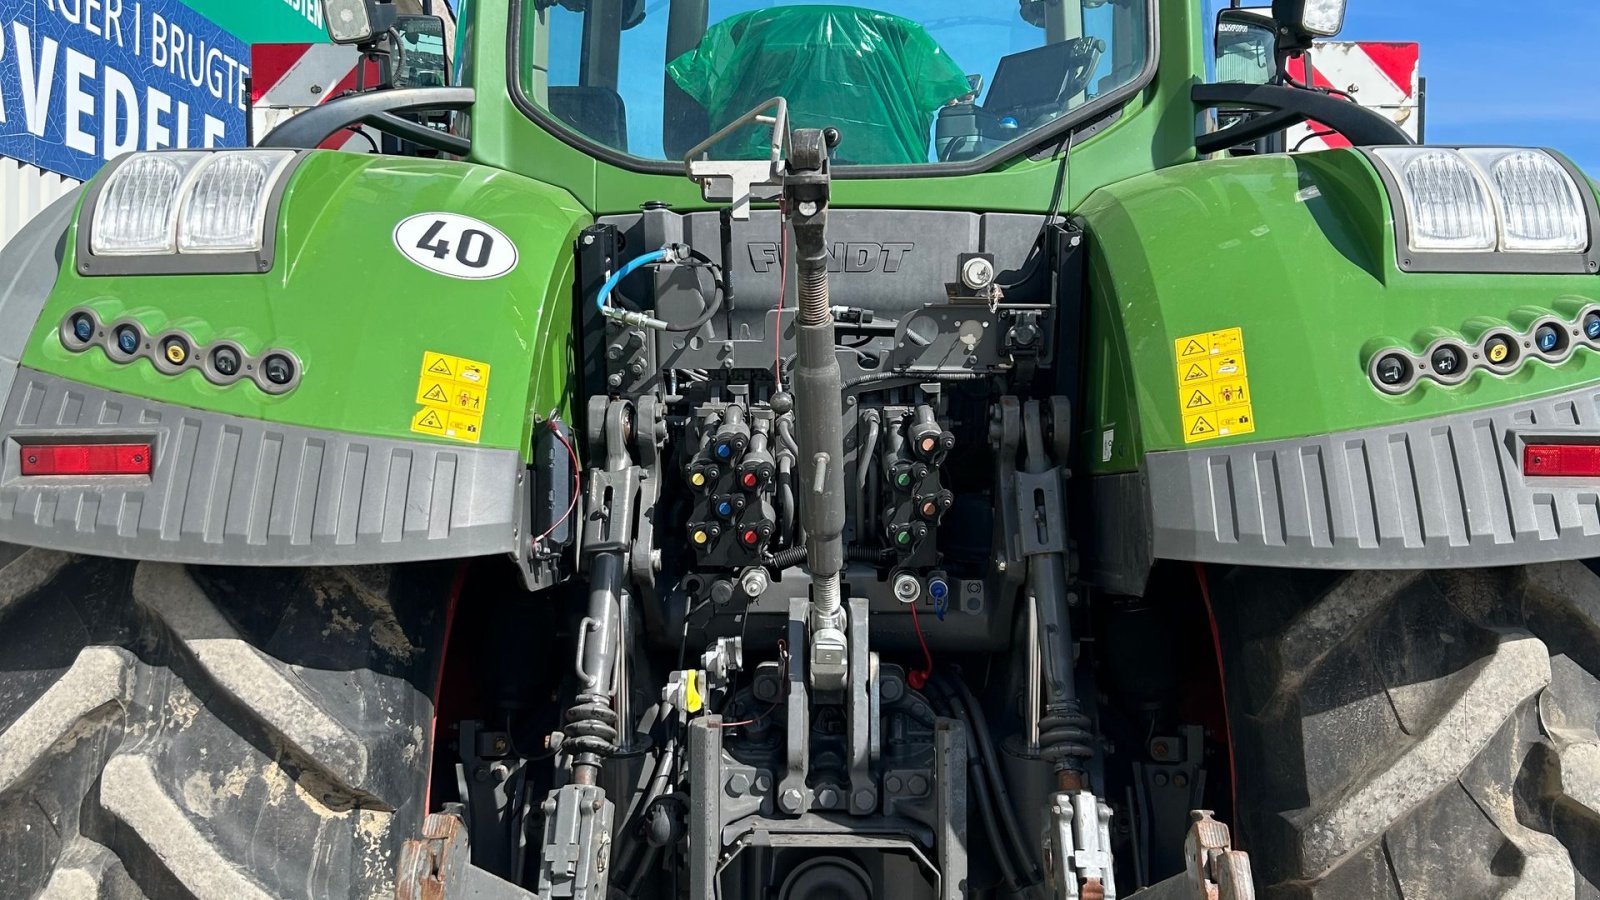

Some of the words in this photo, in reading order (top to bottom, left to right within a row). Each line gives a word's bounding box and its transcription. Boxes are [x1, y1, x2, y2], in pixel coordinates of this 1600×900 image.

[47, 0, 124, 48] ER
[134, 2, 141, 56] I
[151, 12, 250, 112] BRUGTE
[415, 219, 494, 268] 40
[748, 242, 915, 273] FNDT
